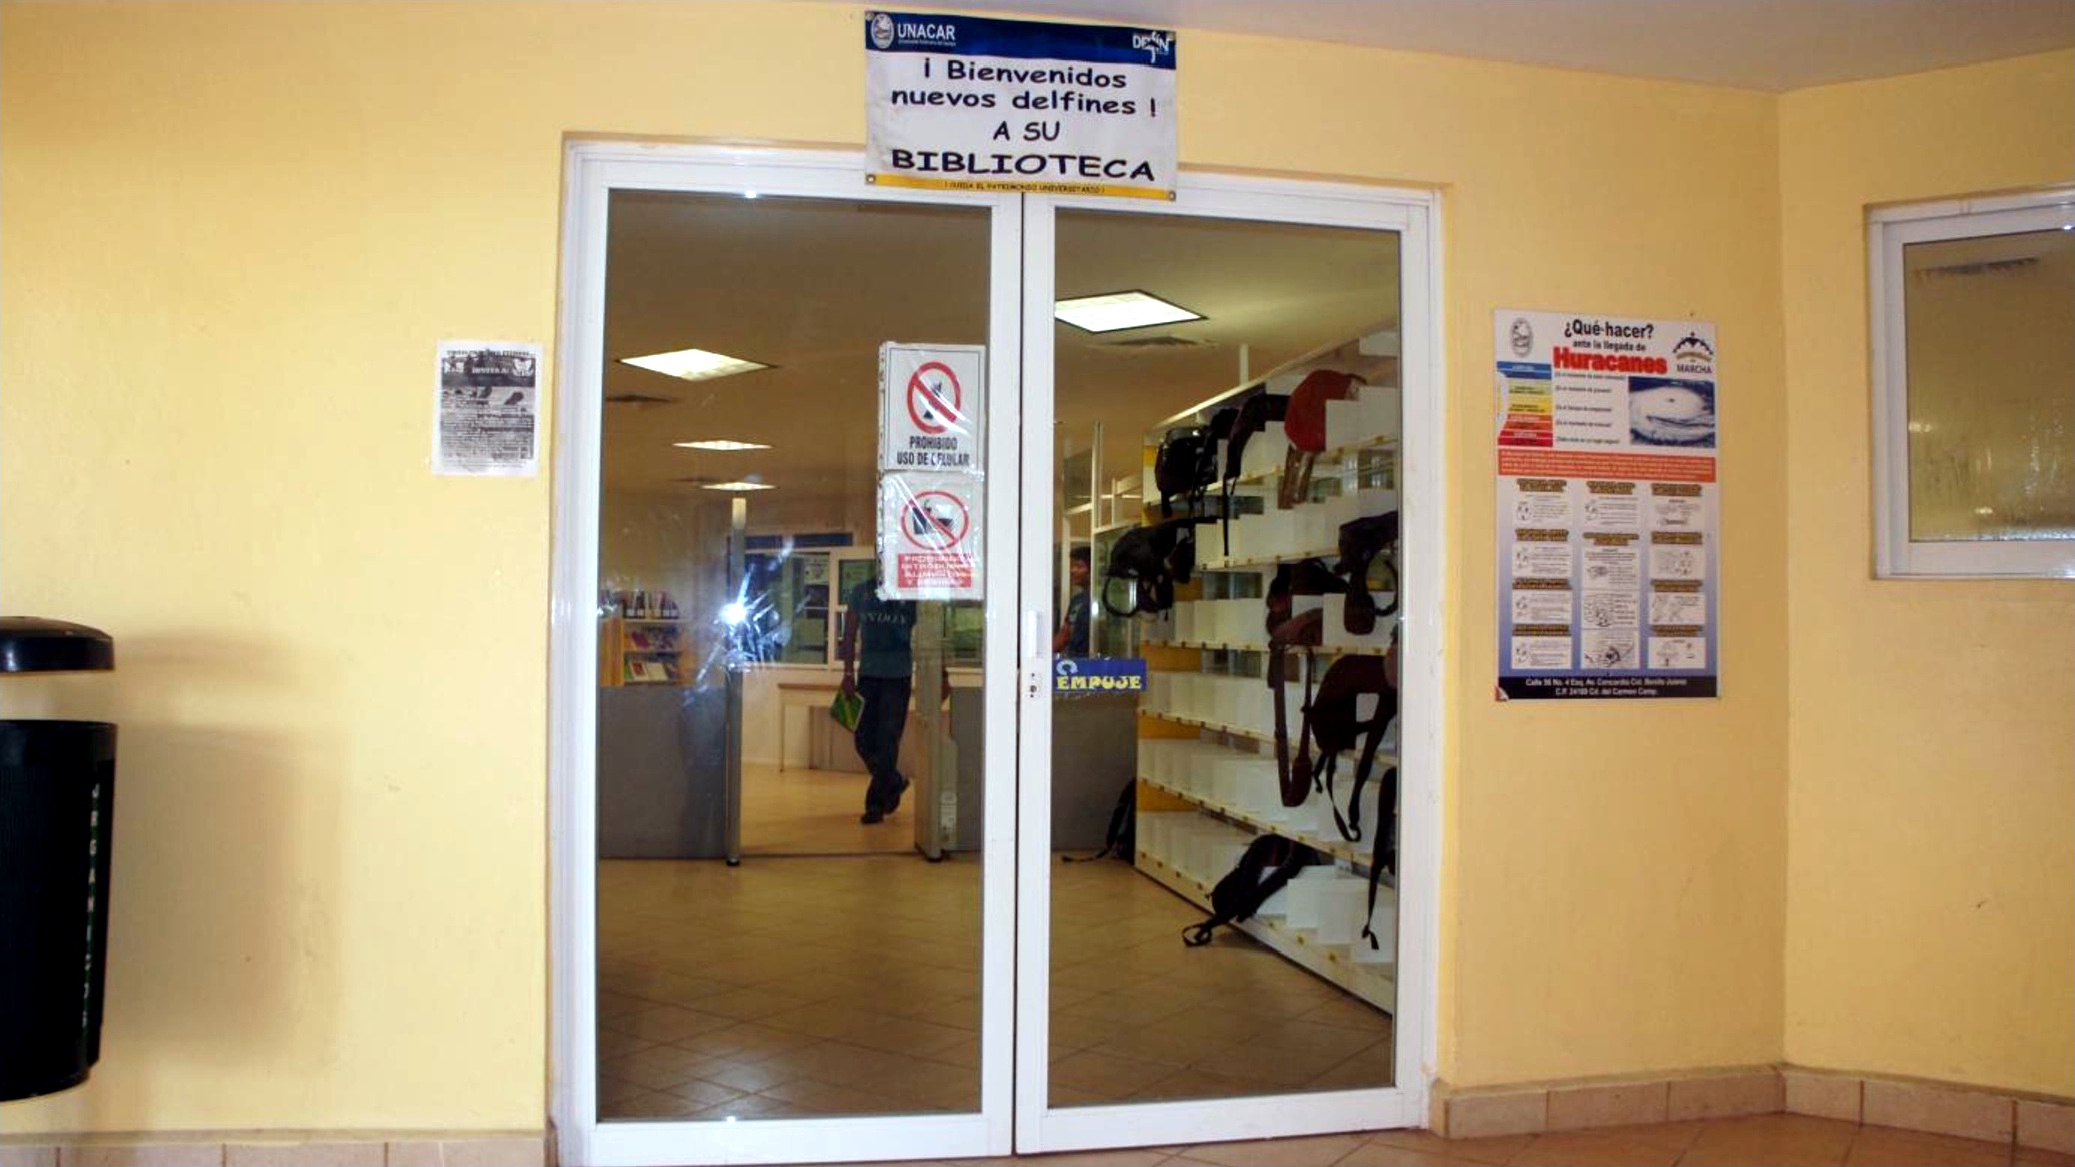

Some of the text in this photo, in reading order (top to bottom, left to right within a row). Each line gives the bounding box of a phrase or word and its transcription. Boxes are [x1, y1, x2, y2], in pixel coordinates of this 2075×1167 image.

[897, 23, 956, 41] UNACAR
[947, 60, 1127, 89] Bienvenidos
[891, 89, 1156, 117] nuevos delfines !
[993, 121, 1060, 141] A SU
[892, 149, 1155, 181] BIBLIOTECA
[1564, 319, 1654, 339] ¿Qué hacer?
[1573, 340, 1646, 352] ante la llegada de
[1553, 347, 1668, 374] Huracanes
[1677, 364, 1713, 374] MARCHA
[909, 436, 958, 450] PROHIBIDO
[897, 452, 914, 465] USO
[917, 452, 928, 465] DE
[1056, 676, 1142, 690] EMPUJE
